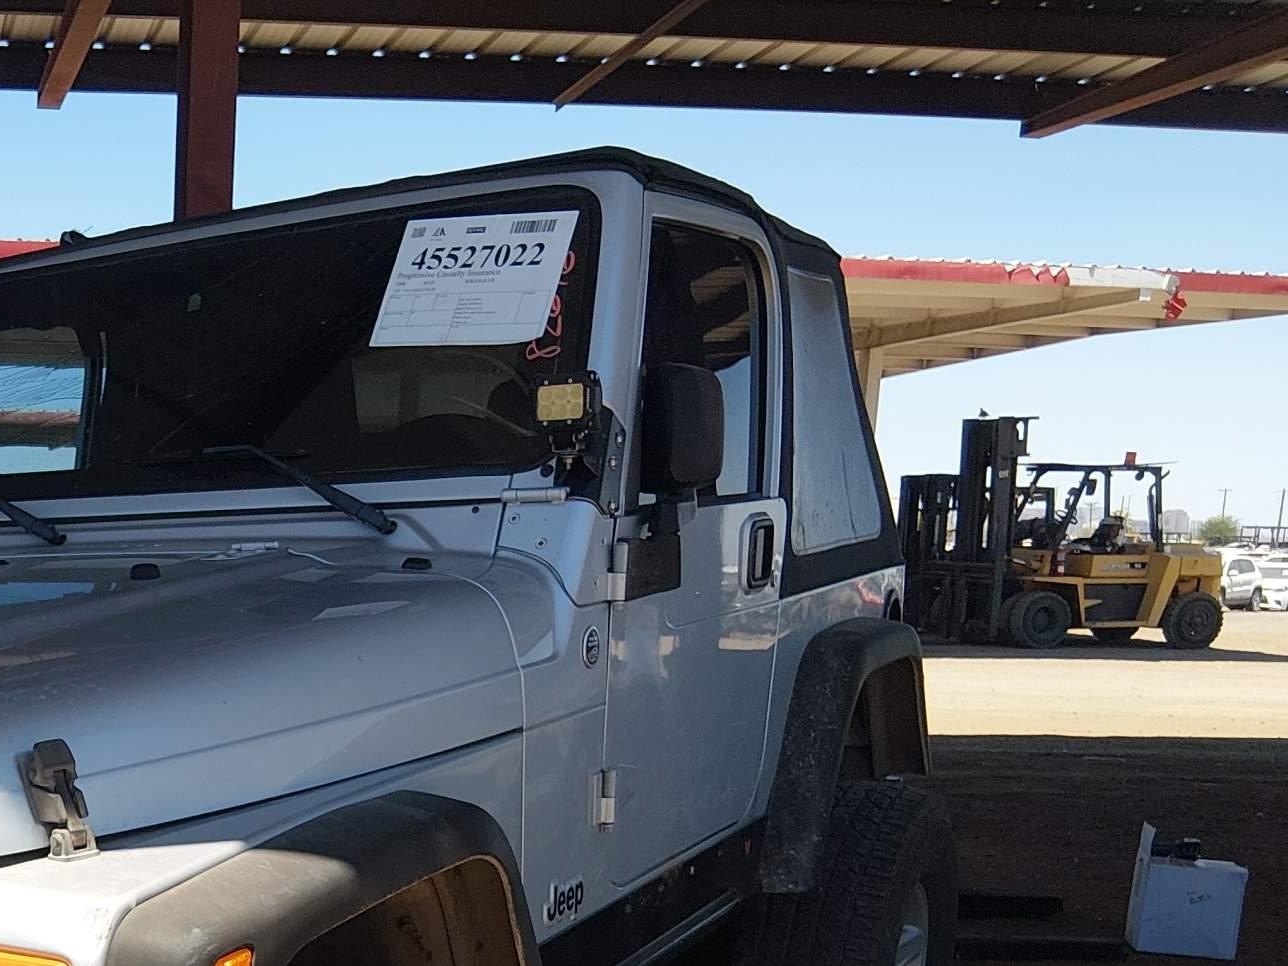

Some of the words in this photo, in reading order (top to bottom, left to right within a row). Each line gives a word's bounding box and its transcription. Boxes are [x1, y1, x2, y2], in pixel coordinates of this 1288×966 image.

[411, 243, 545, 270] 45527022
[396, 272, 436, 281] Progressive
[468, 269, 502, 277] Insurance
[547, 880, 584, 921] Jeep
